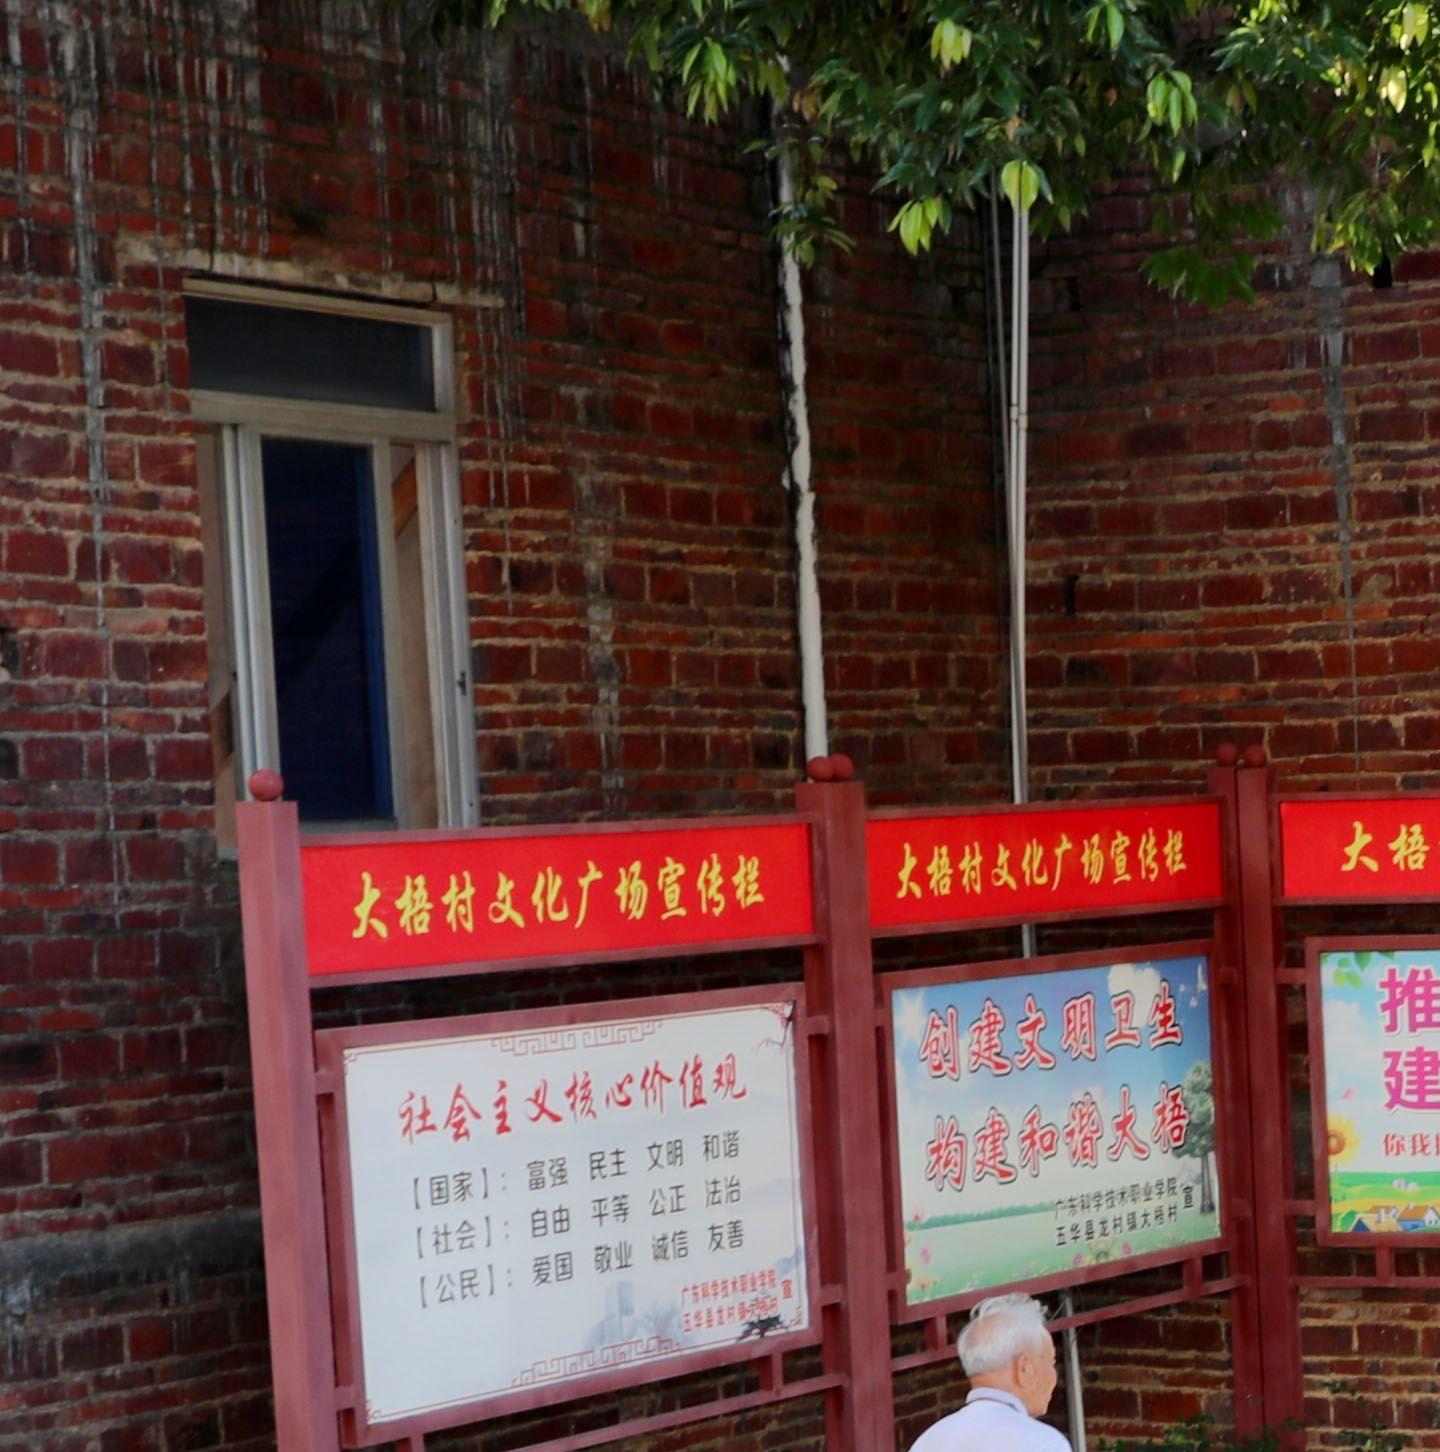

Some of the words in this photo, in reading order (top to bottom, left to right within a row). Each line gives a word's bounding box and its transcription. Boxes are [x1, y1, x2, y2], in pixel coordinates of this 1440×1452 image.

[351, 852, 765, 939] 大梧村文化广场宣传栏
[896, 830, 1187, 899] 大梧村文化广场宣传栏
[920, 979, 1184, 1081] 创建文明卫生
[398, 1052, 750, 1144] 社会主义核心价值观
[926, 1081, 1191, 1191] 构建和谐大梧
[527, 1157, 569, 1191] 富强
[589, 1148, 629, 1182] 民主
[646, 1139, 684, 1171] 文明
[703, 1130, 740, 1162] 和谐
[530, 1204, 571, 1239] 自由
[591, 1194, 630, 1227] 平等
[649, 1184, 687, 1218] 公正
[705, 1175, 743, 1207] 法治
[532, 1251, 574, 1287] 爱国
[593, 1240, 633, 1274] 敬业
[651, 1230, 689, 1263] 诚信
[707, 1219, 745, 1253] 友善
